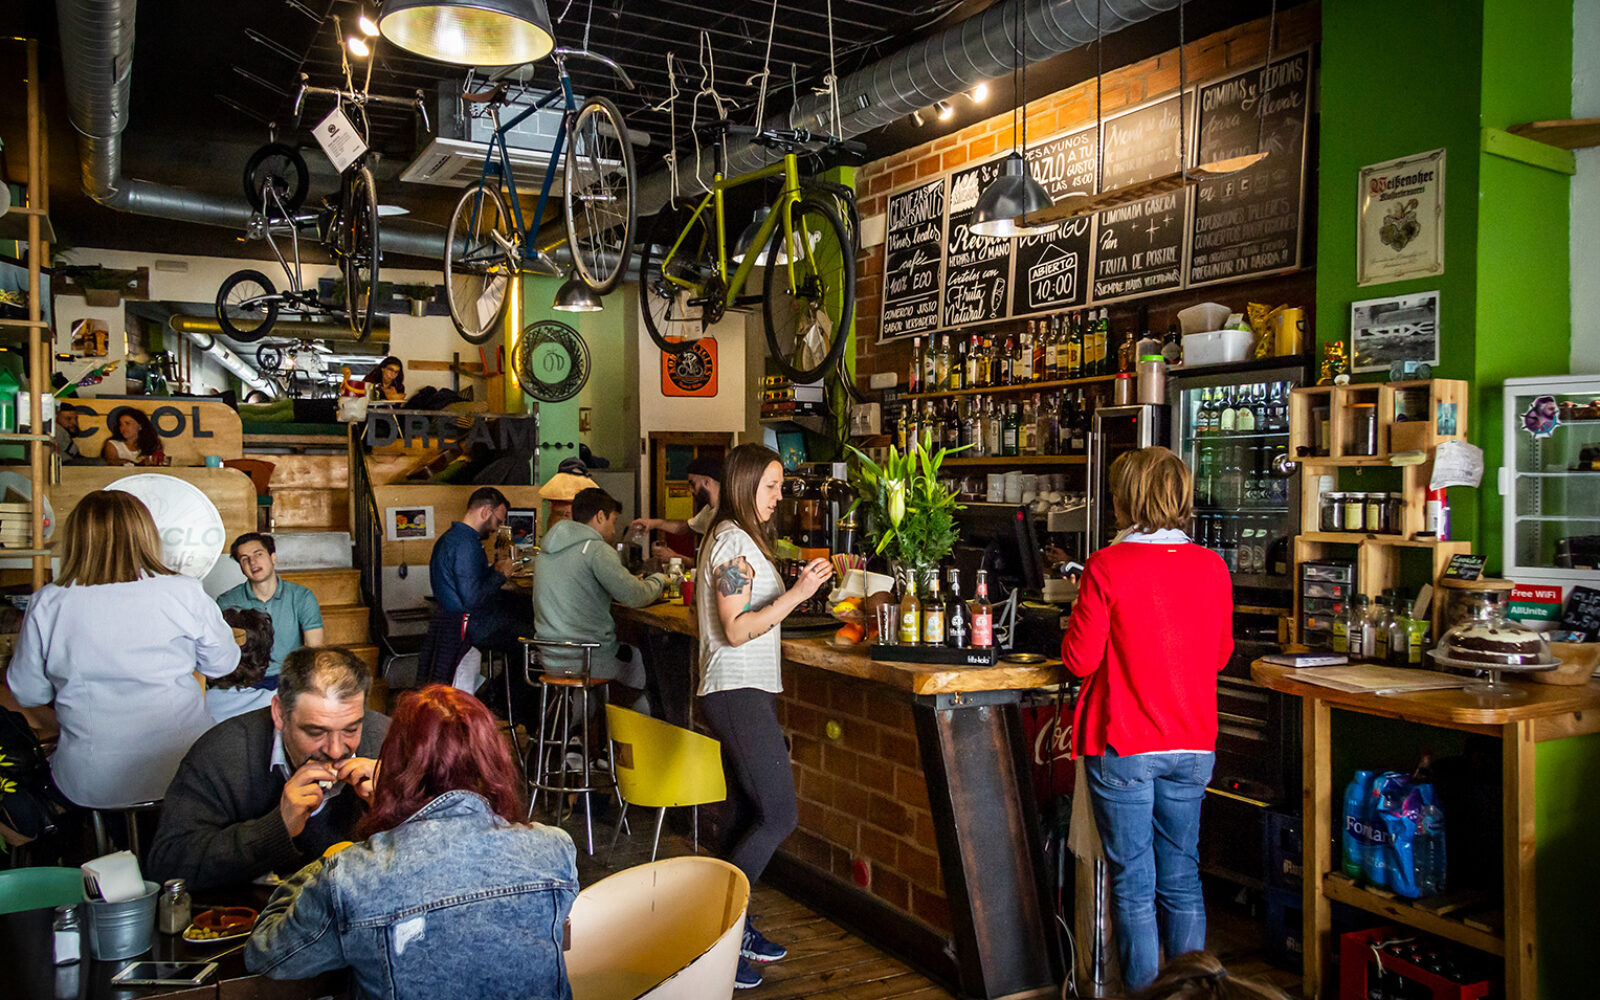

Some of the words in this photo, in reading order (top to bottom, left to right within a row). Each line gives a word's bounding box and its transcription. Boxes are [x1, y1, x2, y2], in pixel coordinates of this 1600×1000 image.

[1203, 79, 1247, 112] COMIDAS
[1067, 151, 1077, 163] A
[1079, 144, 1093, 159] TU
[1067, 158, 1095, 177] GUSTO
[1052, 180, 1068, 193] LAS
[1102, 203, 1142, 226] LIMONADA
[1100, 229, 1118, 250] Pan
[1032, 257, 1074, 279] ABIERTO
[1100, 255, 1128, 276] FRUTA
[1146, 245, 1178, 267] POSTRE
[913, 270, 932, 290] ECO
[1036, 272, 1073, 300] 10:00
[884, 305, 914, 320] COMERCIO
[916, 301, 937, 315] JUSTO
[1511, 588, 1533, 599] Free
[1535, 590, 1556, 600] WiFi
[1511, 605, 1548, 617] AllUnite
